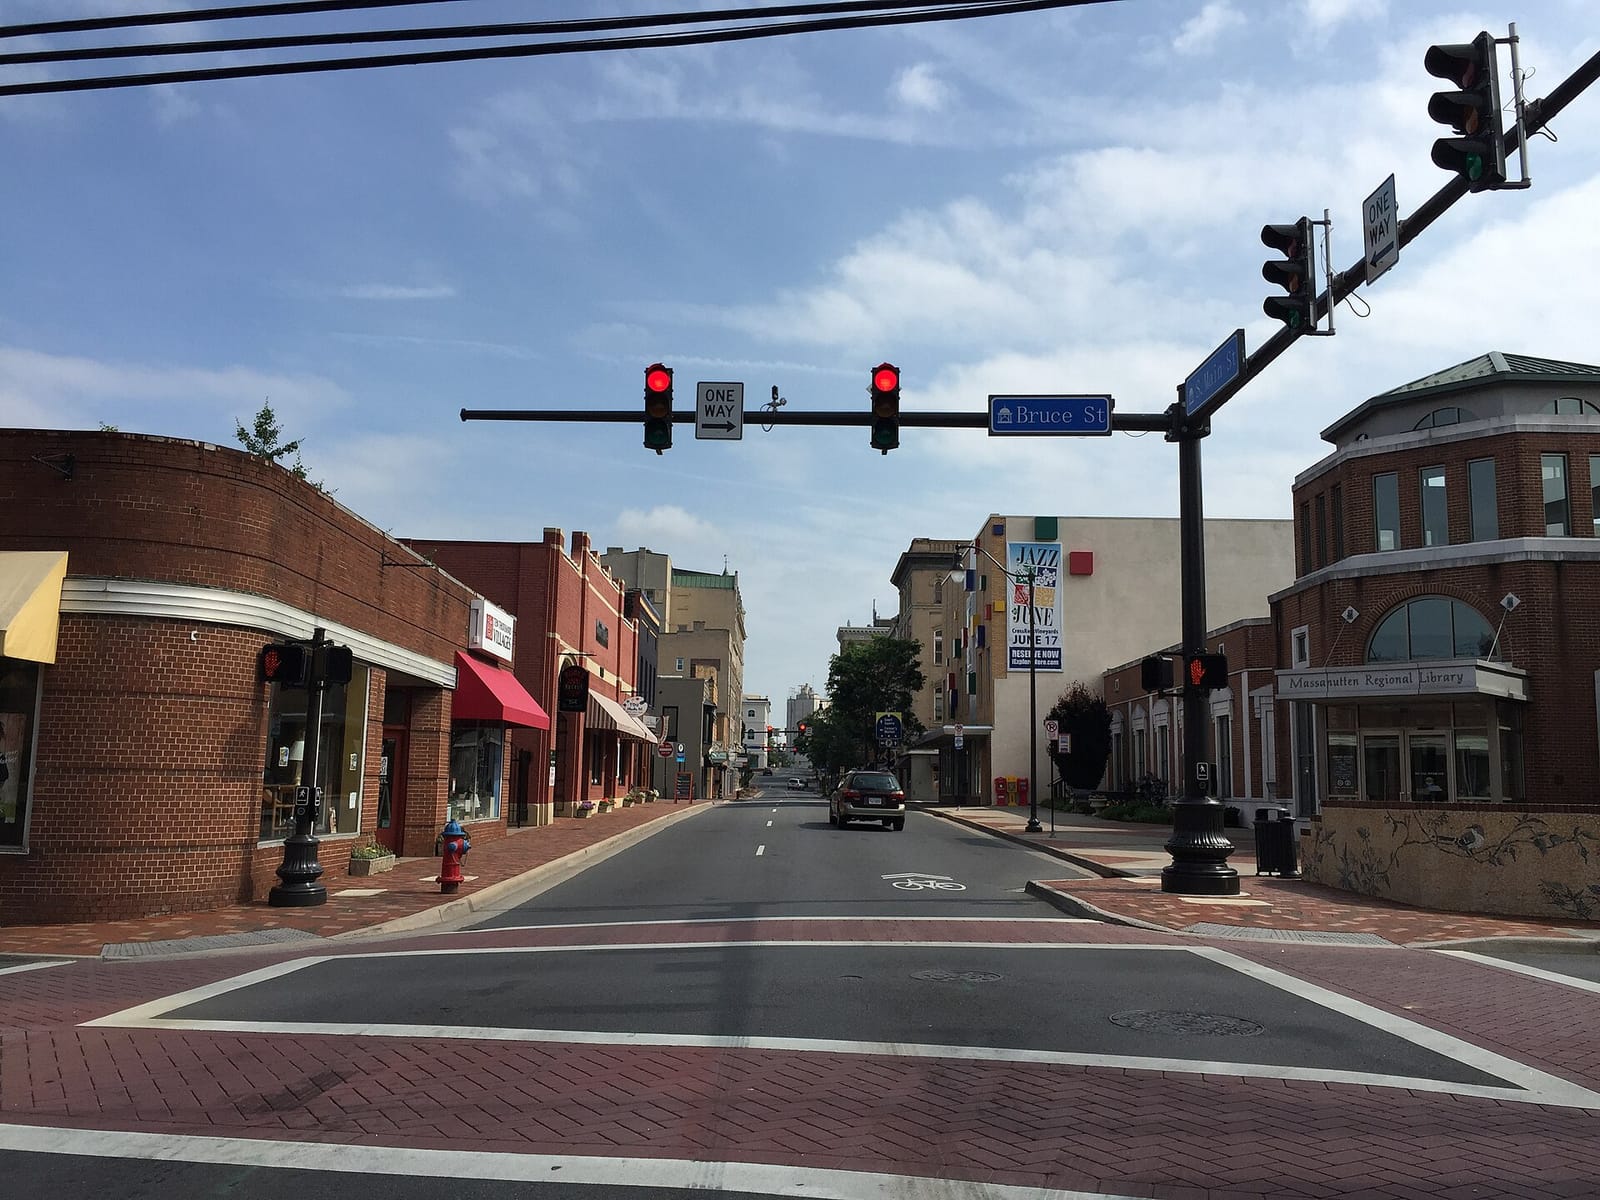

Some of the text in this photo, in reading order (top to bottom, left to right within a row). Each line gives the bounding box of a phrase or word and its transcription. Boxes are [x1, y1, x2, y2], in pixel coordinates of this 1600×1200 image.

[1370, 191, 1389, 224] ONE
[1370, 214, 1390, 247] WAY
[1226, 350, 1236, 372] St
[705, 389, 735, 402] ONE
[704, 404, 736, 417] WAY
[1016, 406, 1105, 424] Bruce St
[1015, 546, 1059, 567] JAZZ
[1012, 605, 1054, 627] JUNE
[1045, 635, 1058, 645] 17
[1042, 650, 1059, 659] NOW
[1289, 671, 1463, 689] Massanutten Regional Library
